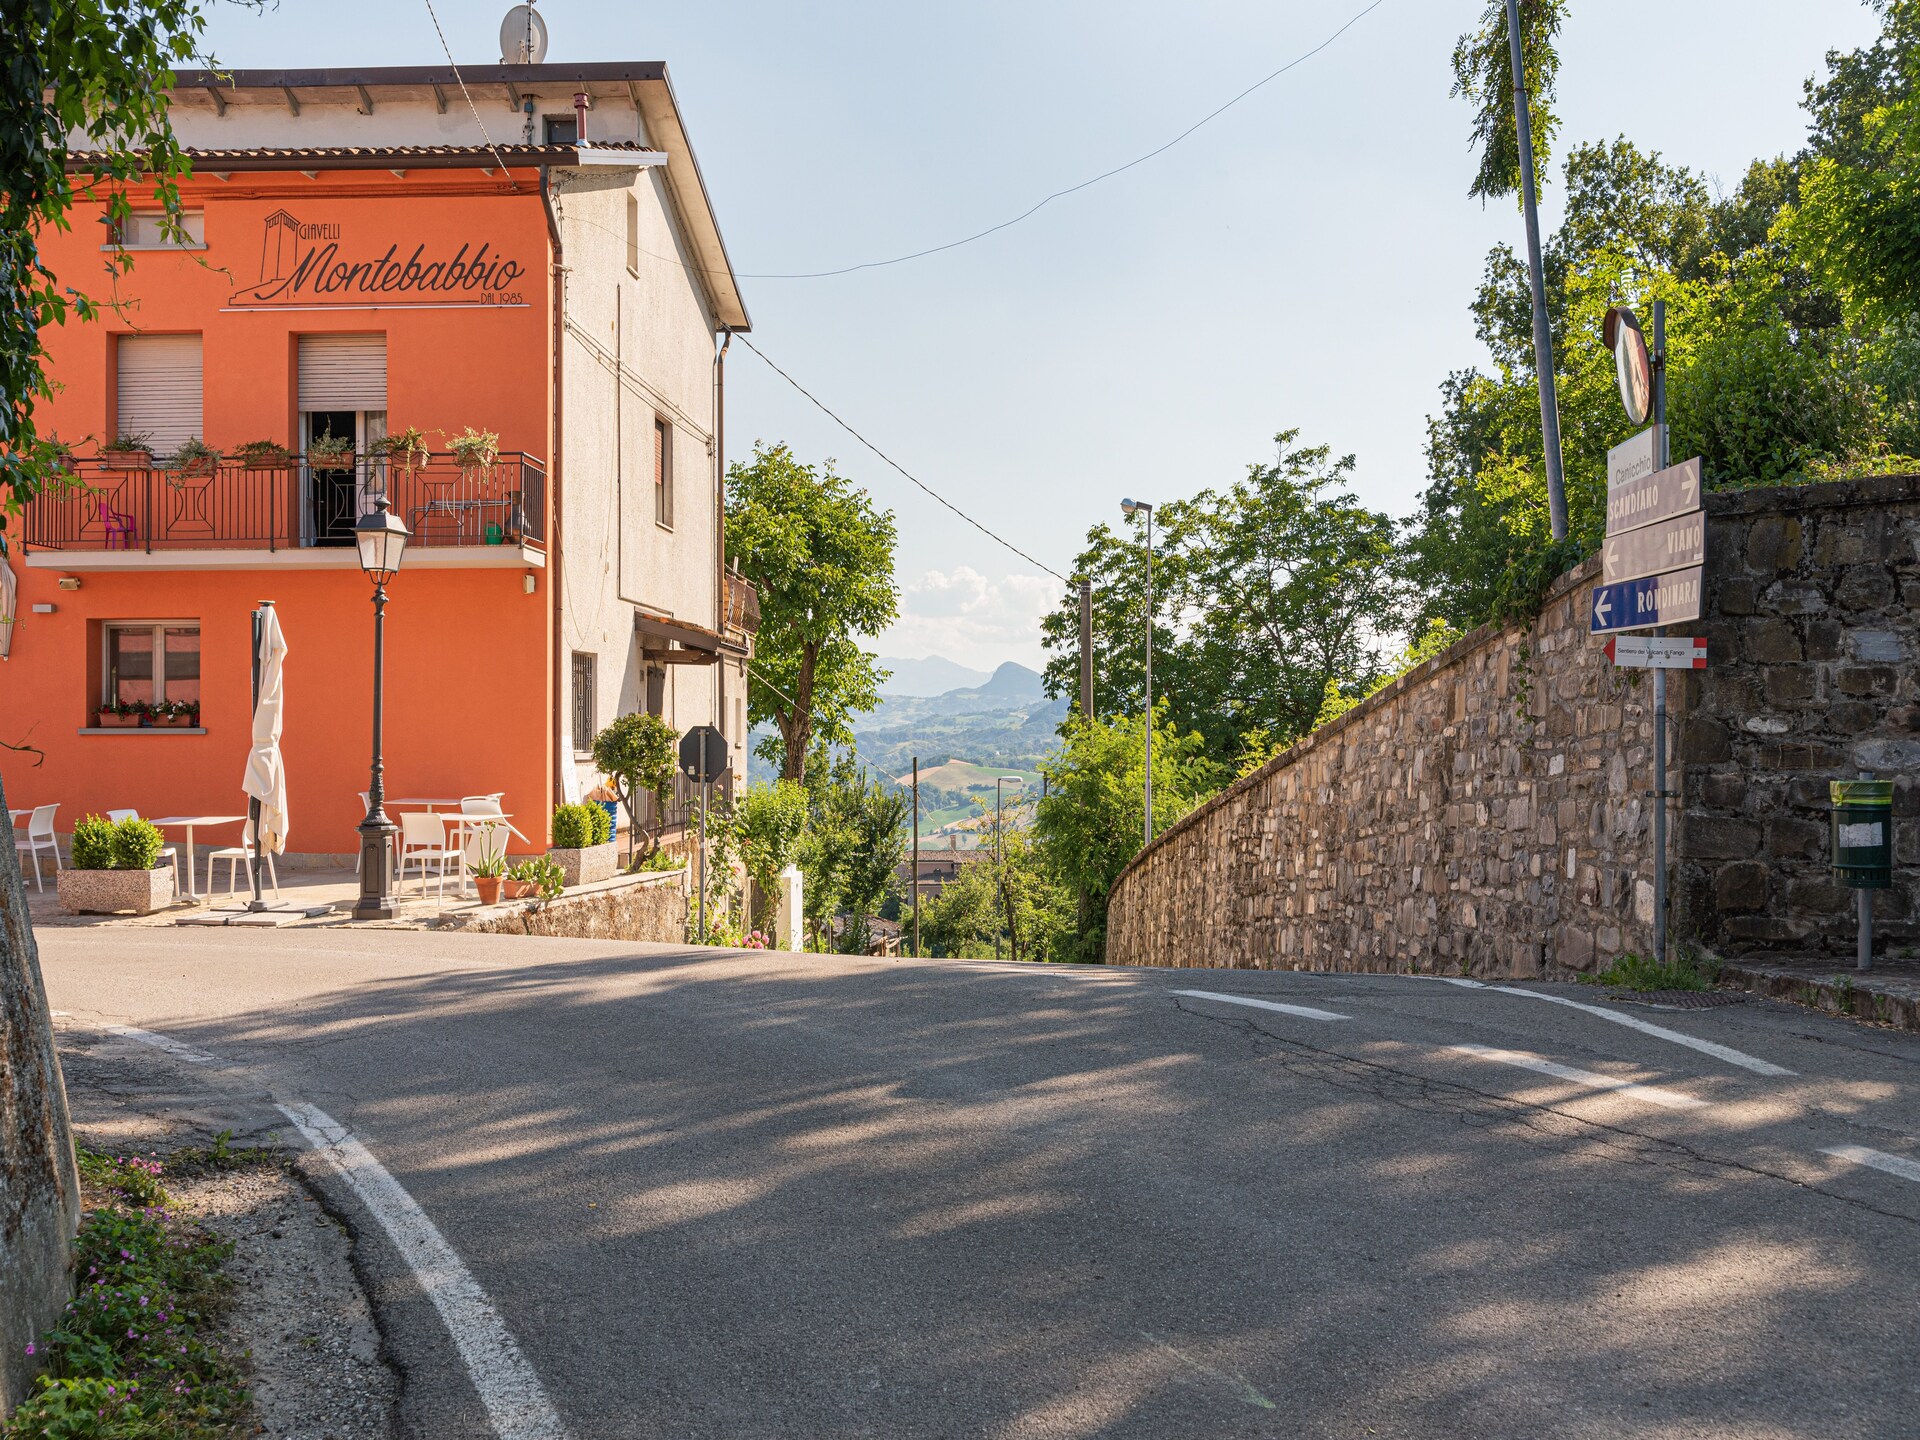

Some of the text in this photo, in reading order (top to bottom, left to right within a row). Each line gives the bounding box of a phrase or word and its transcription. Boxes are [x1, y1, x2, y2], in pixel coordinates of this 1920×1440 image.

[299, 223, 341, 240] GIAVELLI
[254, 242, 525, 300] Montebabbio
[480, 292, 523, 305] DAL 1985
[1615, 455, 1651, 485] Canicchio
[1608, 484, 1659, 522] SCANDIANO
[1667, 524, 1700, 554] VIANO
[1637, 579, 1698, 614] RONDINARA
[1617, 647, 1637, 655] Sentiero
[1669, 649, 1686, 657] Fango
